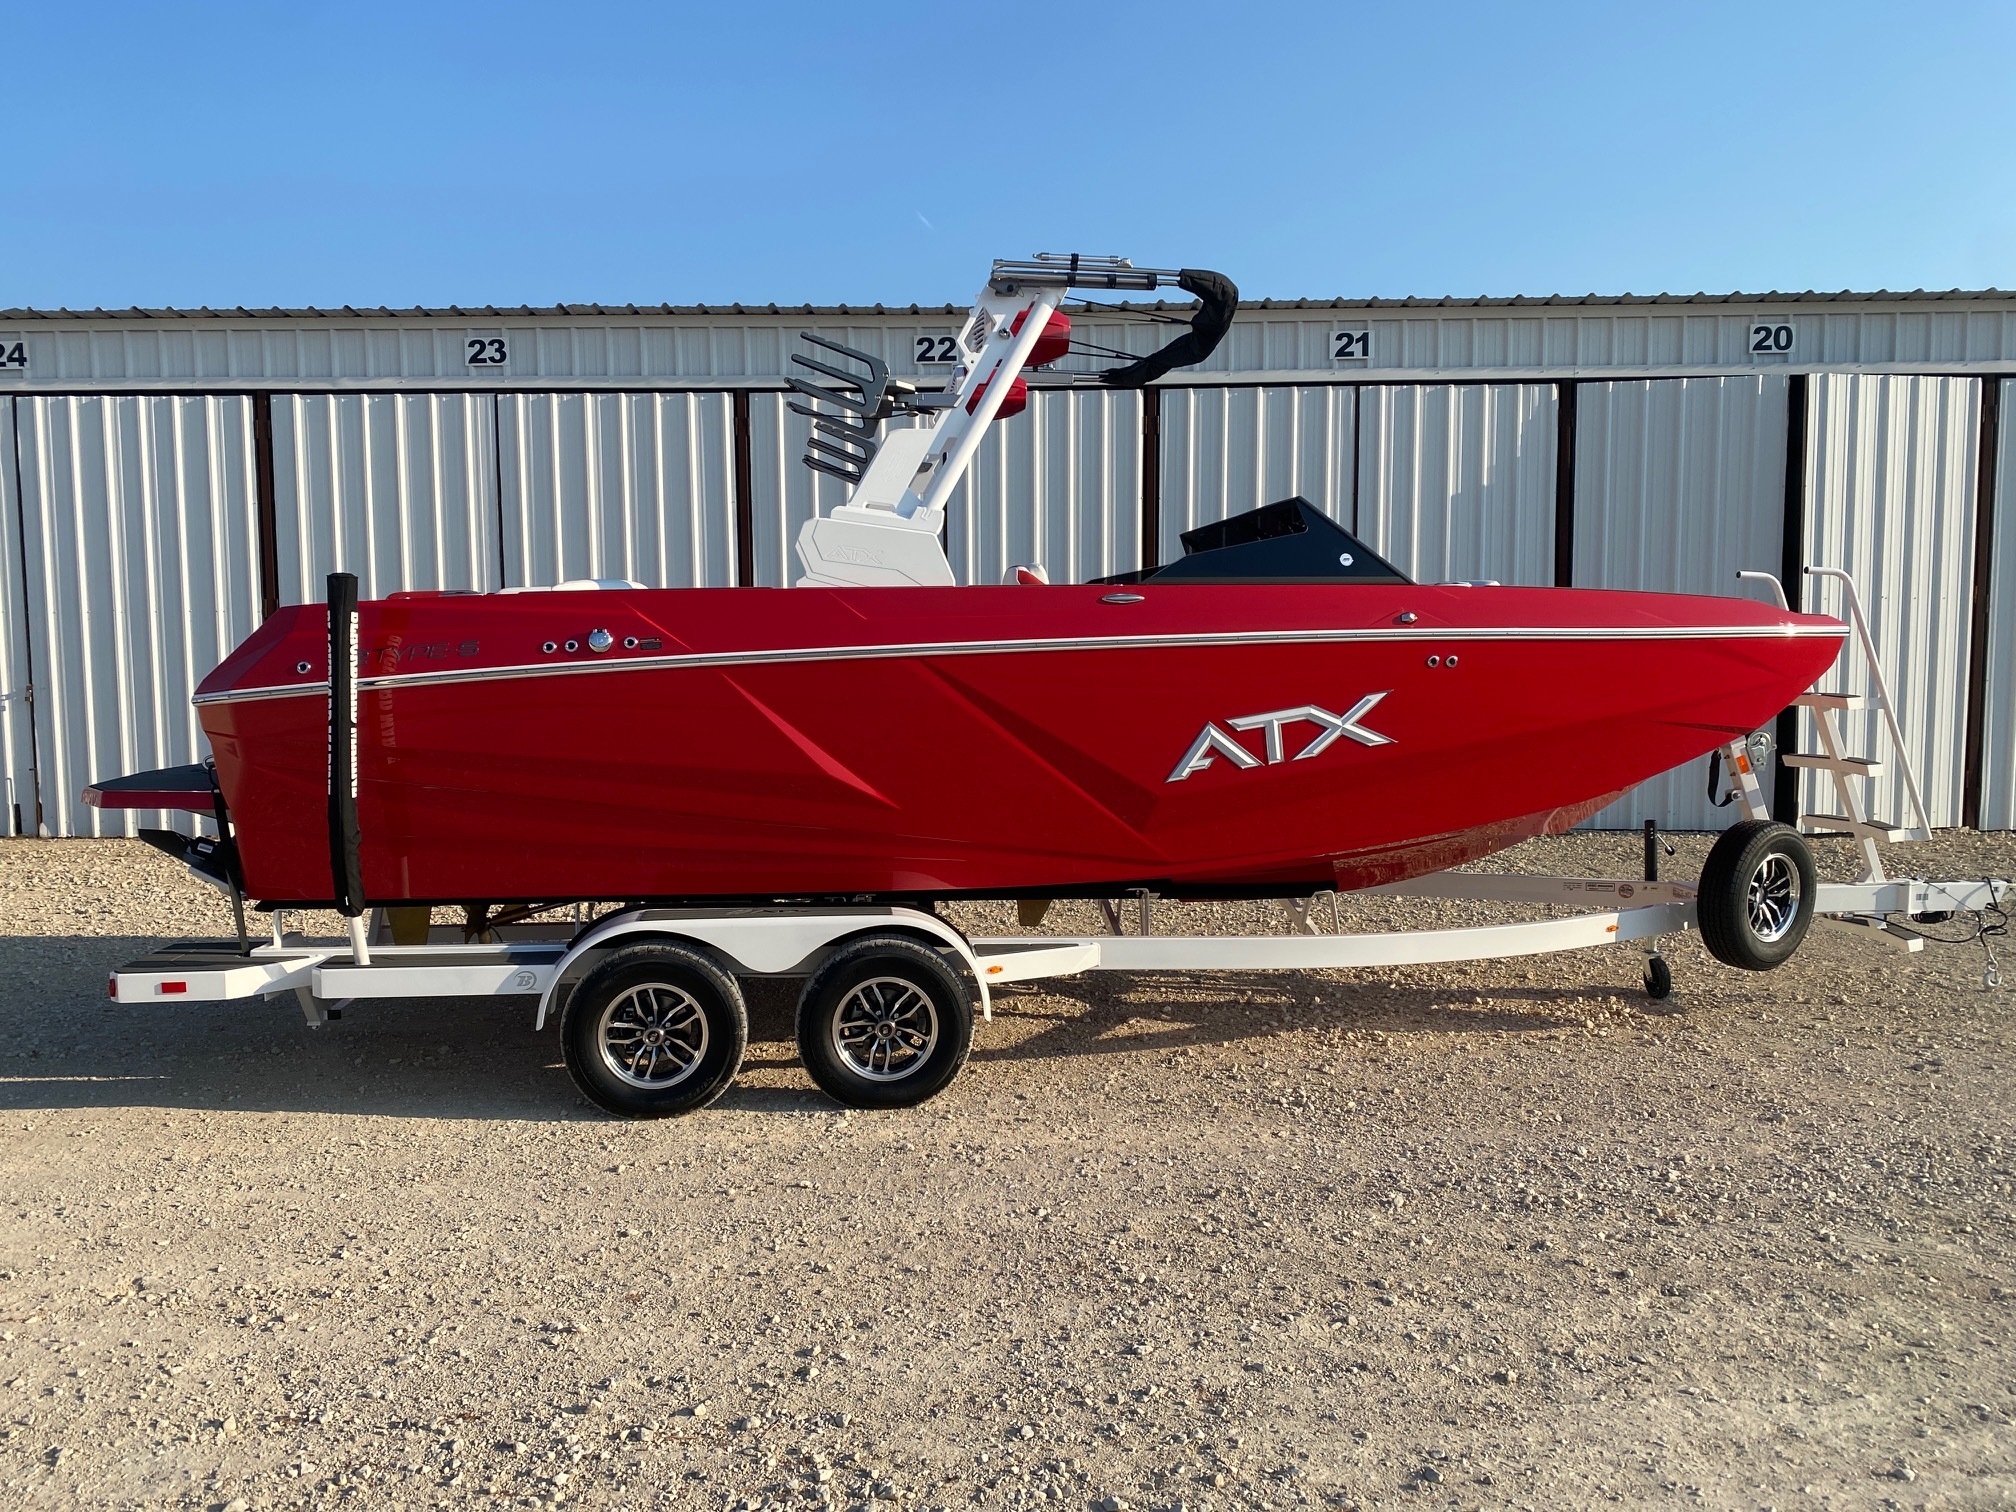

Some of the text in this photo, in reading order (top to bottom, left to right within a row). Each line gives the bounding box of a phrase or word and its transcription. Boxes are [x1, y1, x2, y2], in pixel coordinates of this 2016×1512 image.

[467, 338, 507, 364] 23
[915, 336, 957, 362] 22
[1334, 331, 1370, 358] 21
[1751, 325, 1794, 351] 20
[824, 544, 884, 565] ATX
[375, 639, 480, 664] TYPE-S
[1164, 689, 1399, 784] ATX
